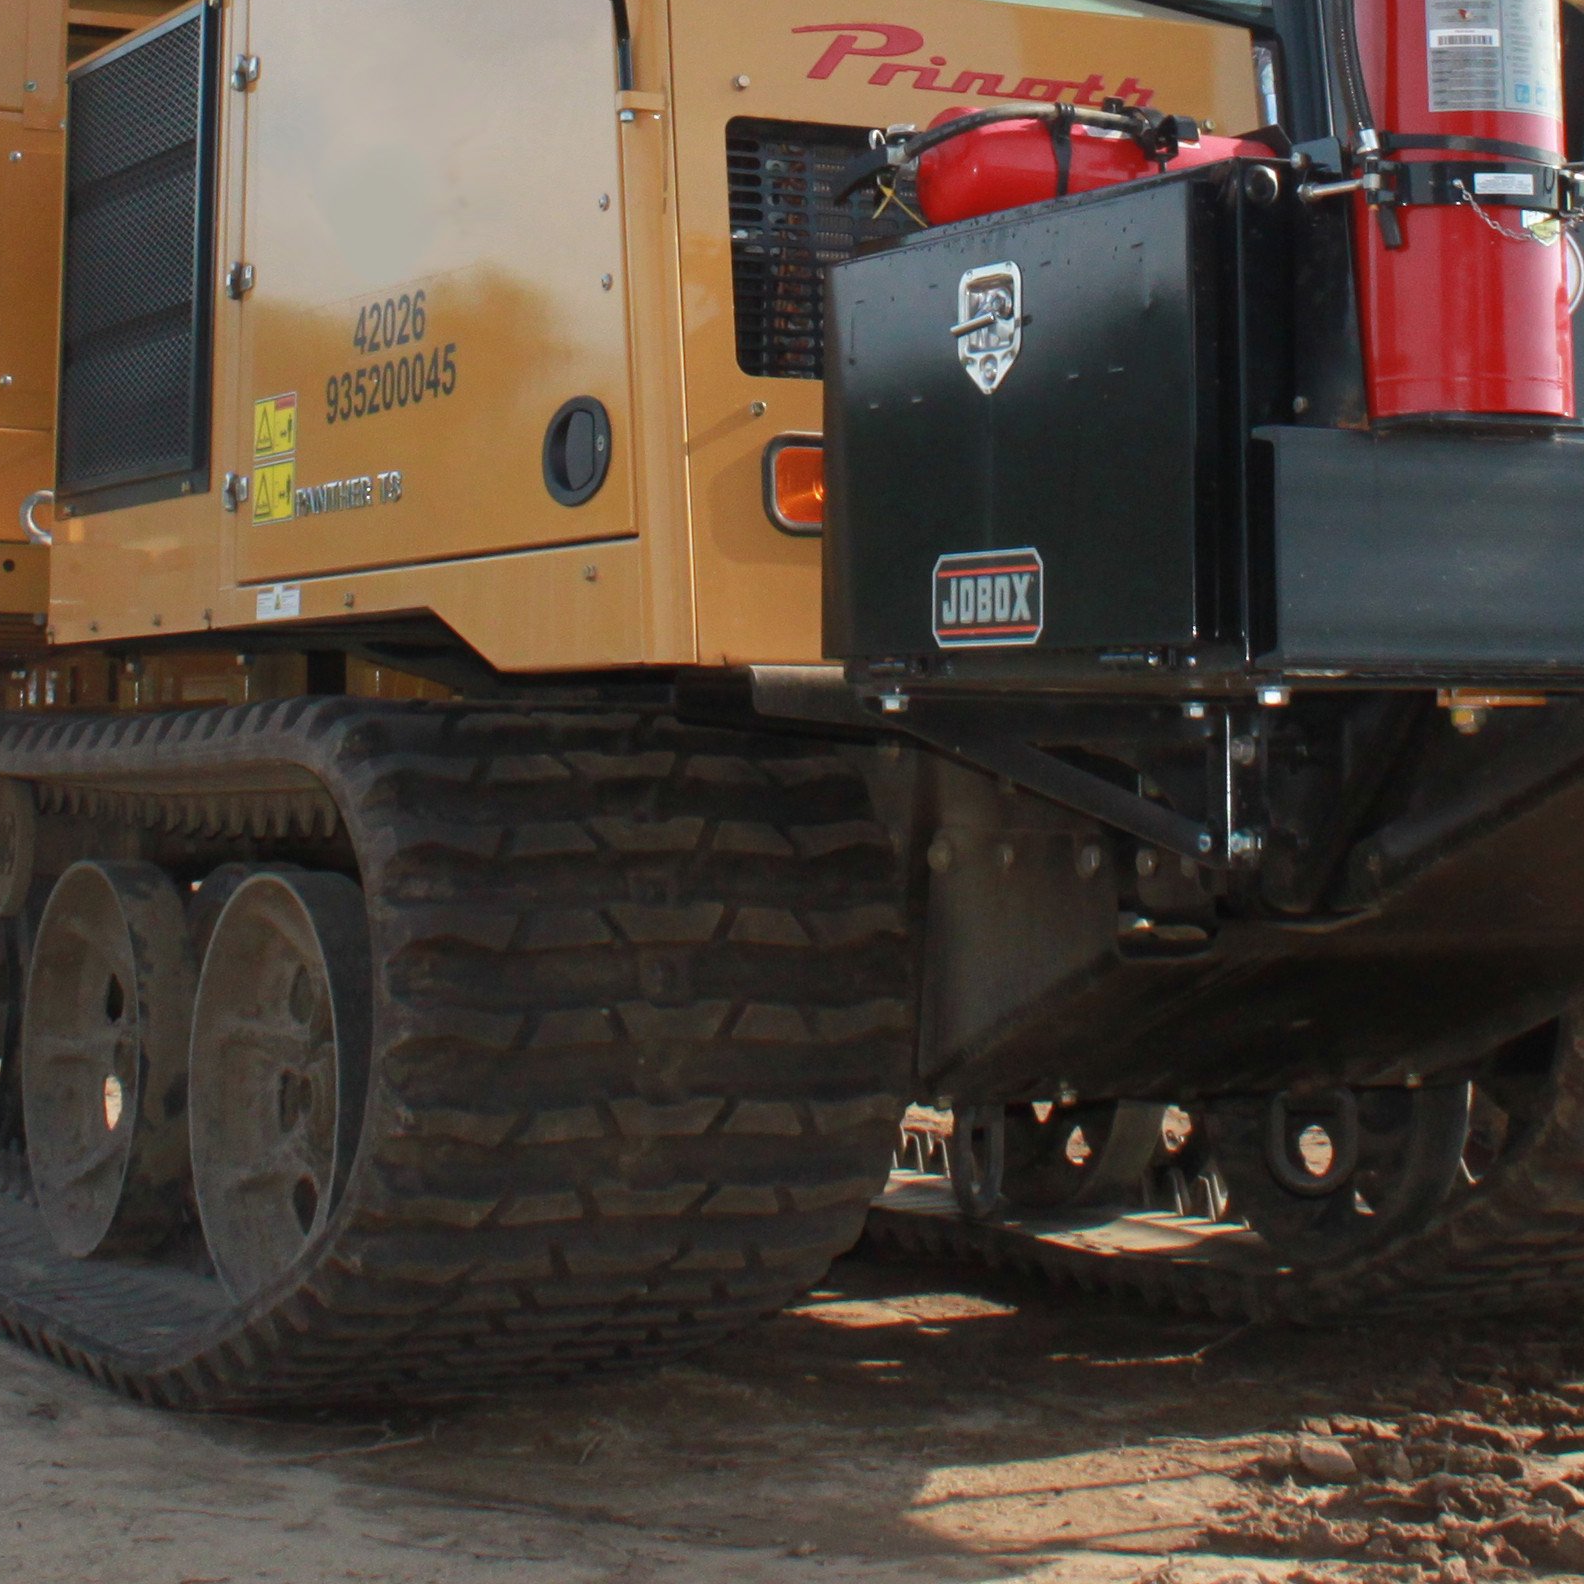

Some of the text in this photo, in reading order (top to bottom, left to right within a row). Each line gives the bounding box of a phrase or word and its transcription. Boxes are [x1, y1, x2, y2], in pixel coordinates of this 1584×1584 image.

[791, 23, 1155, 108] Prinoth
[354, 290, 426, 353] 42026
[327, 343, 456, 424] 935200045
[295, 476, 372, 517] PANTHER
[942, 572, 1032, 625] JOBOX
